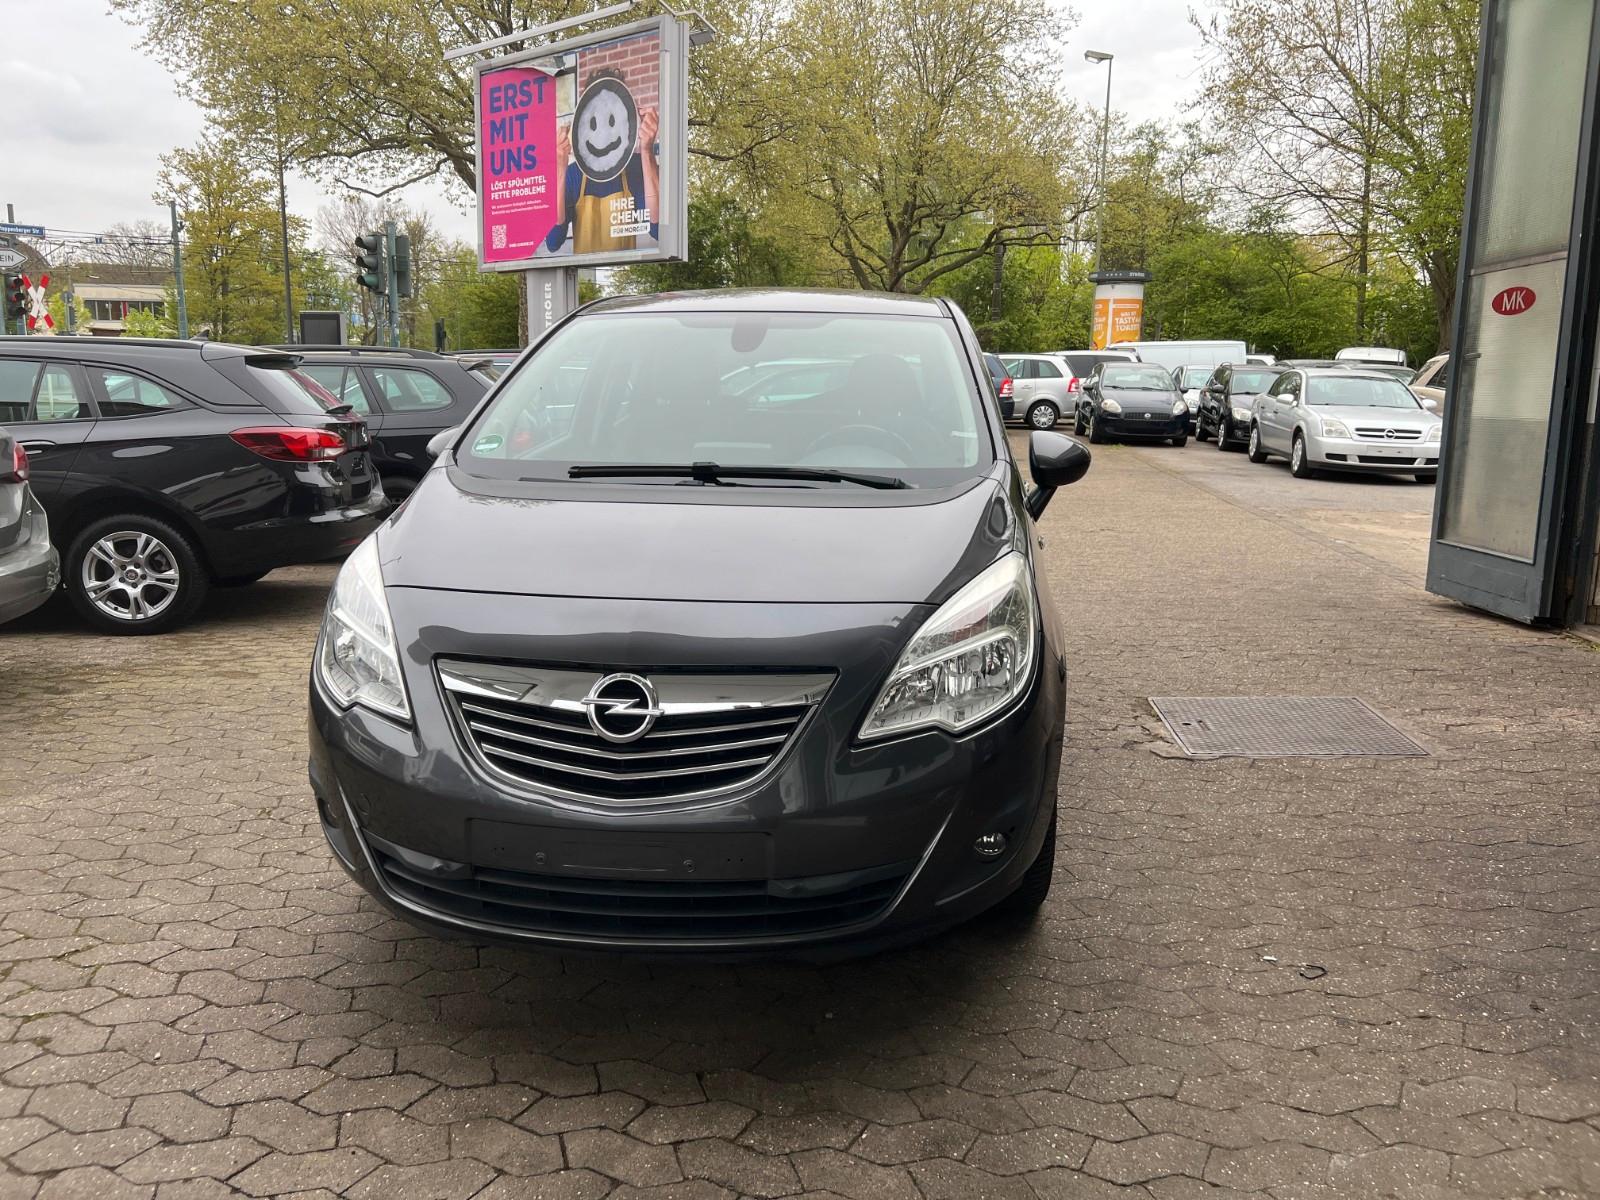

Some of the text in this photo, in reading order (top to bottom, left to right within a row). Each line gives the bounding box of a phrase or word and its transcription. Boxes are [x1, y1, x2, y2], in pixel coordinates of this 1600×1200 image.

[489, 76, 548, 114] ERST
[489, 112, 529, 146] MIT
[490, 144, 538, 177] UNS
[491, 175, 546, 191] LÖST SPÜLMITTEL
[491, 185, 546, 200] FETTE PROBLEME
[610, 197, 635, 211] IHRE
[610, 208, 651, 224] CHEMIE
[1502, 289, 1527, 311] MK
